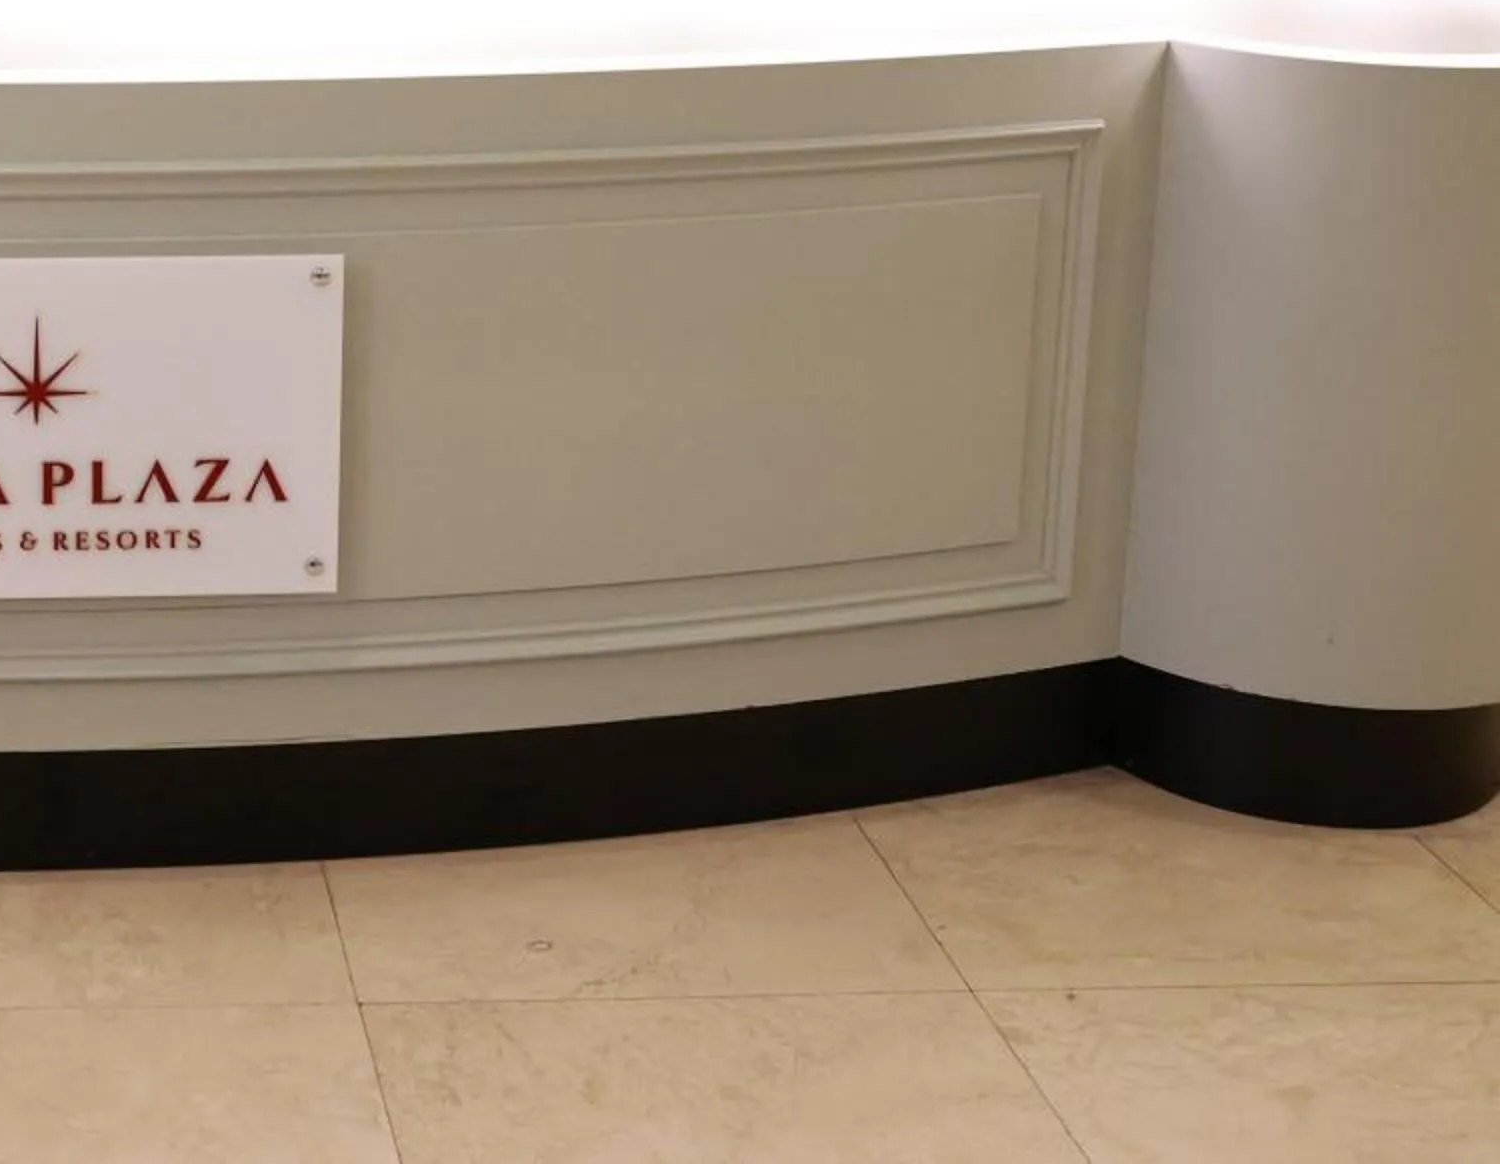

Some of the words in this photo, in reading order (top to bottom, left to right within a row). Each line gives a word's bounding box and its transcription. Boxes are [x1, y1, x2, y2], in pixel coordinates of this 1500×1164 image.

[41, 458, 288, 507] PLAZA
[19, 531, 38, 552] &
[53, 529, 203, 552] RESORTS
